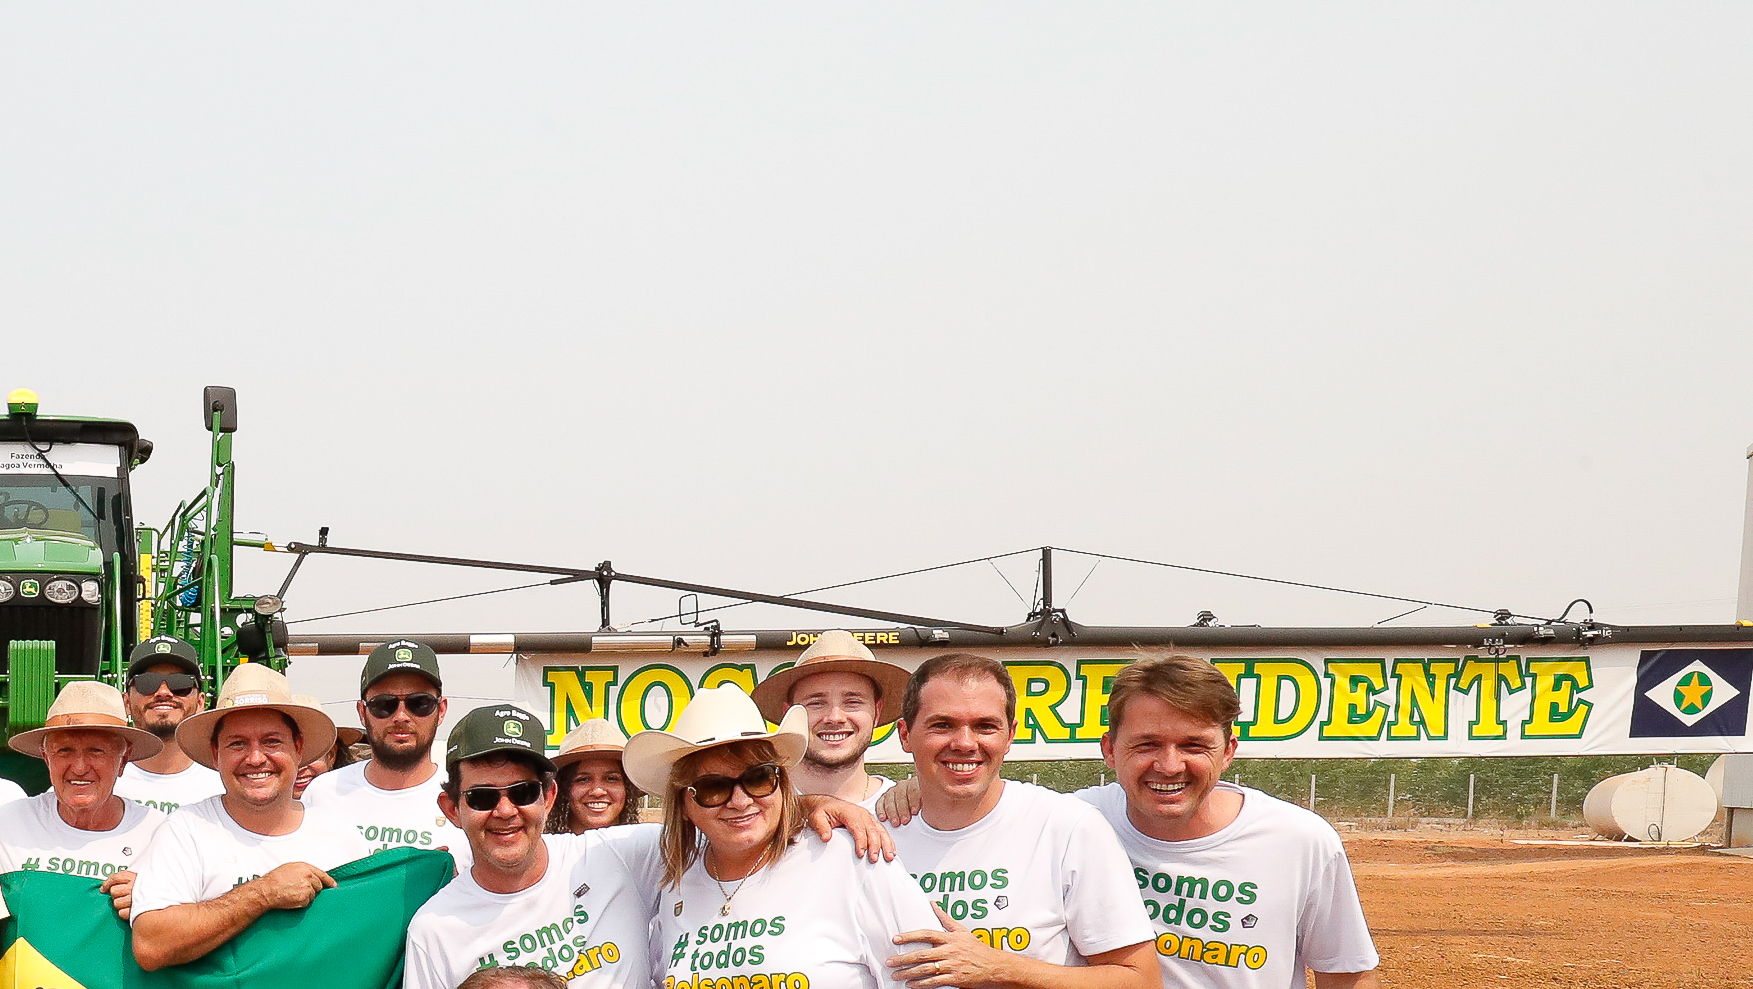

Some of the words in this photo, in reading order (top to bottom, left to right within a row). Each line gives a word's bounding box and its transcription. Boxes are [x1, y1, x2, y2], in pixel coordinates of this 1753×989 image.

[786, 631, 823, 646] JOH
[851, 631, 900, 645] EERE
[493, 736, 512, 744] JOHN
[356, 825, 433, 845] omos
[909, 867, 1009, 893] omos
[1133, 866, 1259, 905] somos
[1143, 897, 1232, 933] odos
[695, 915, 786, 946] somos
[689, 942, 765, 972] todos
[1155, 931, 1268, 970] onaro
